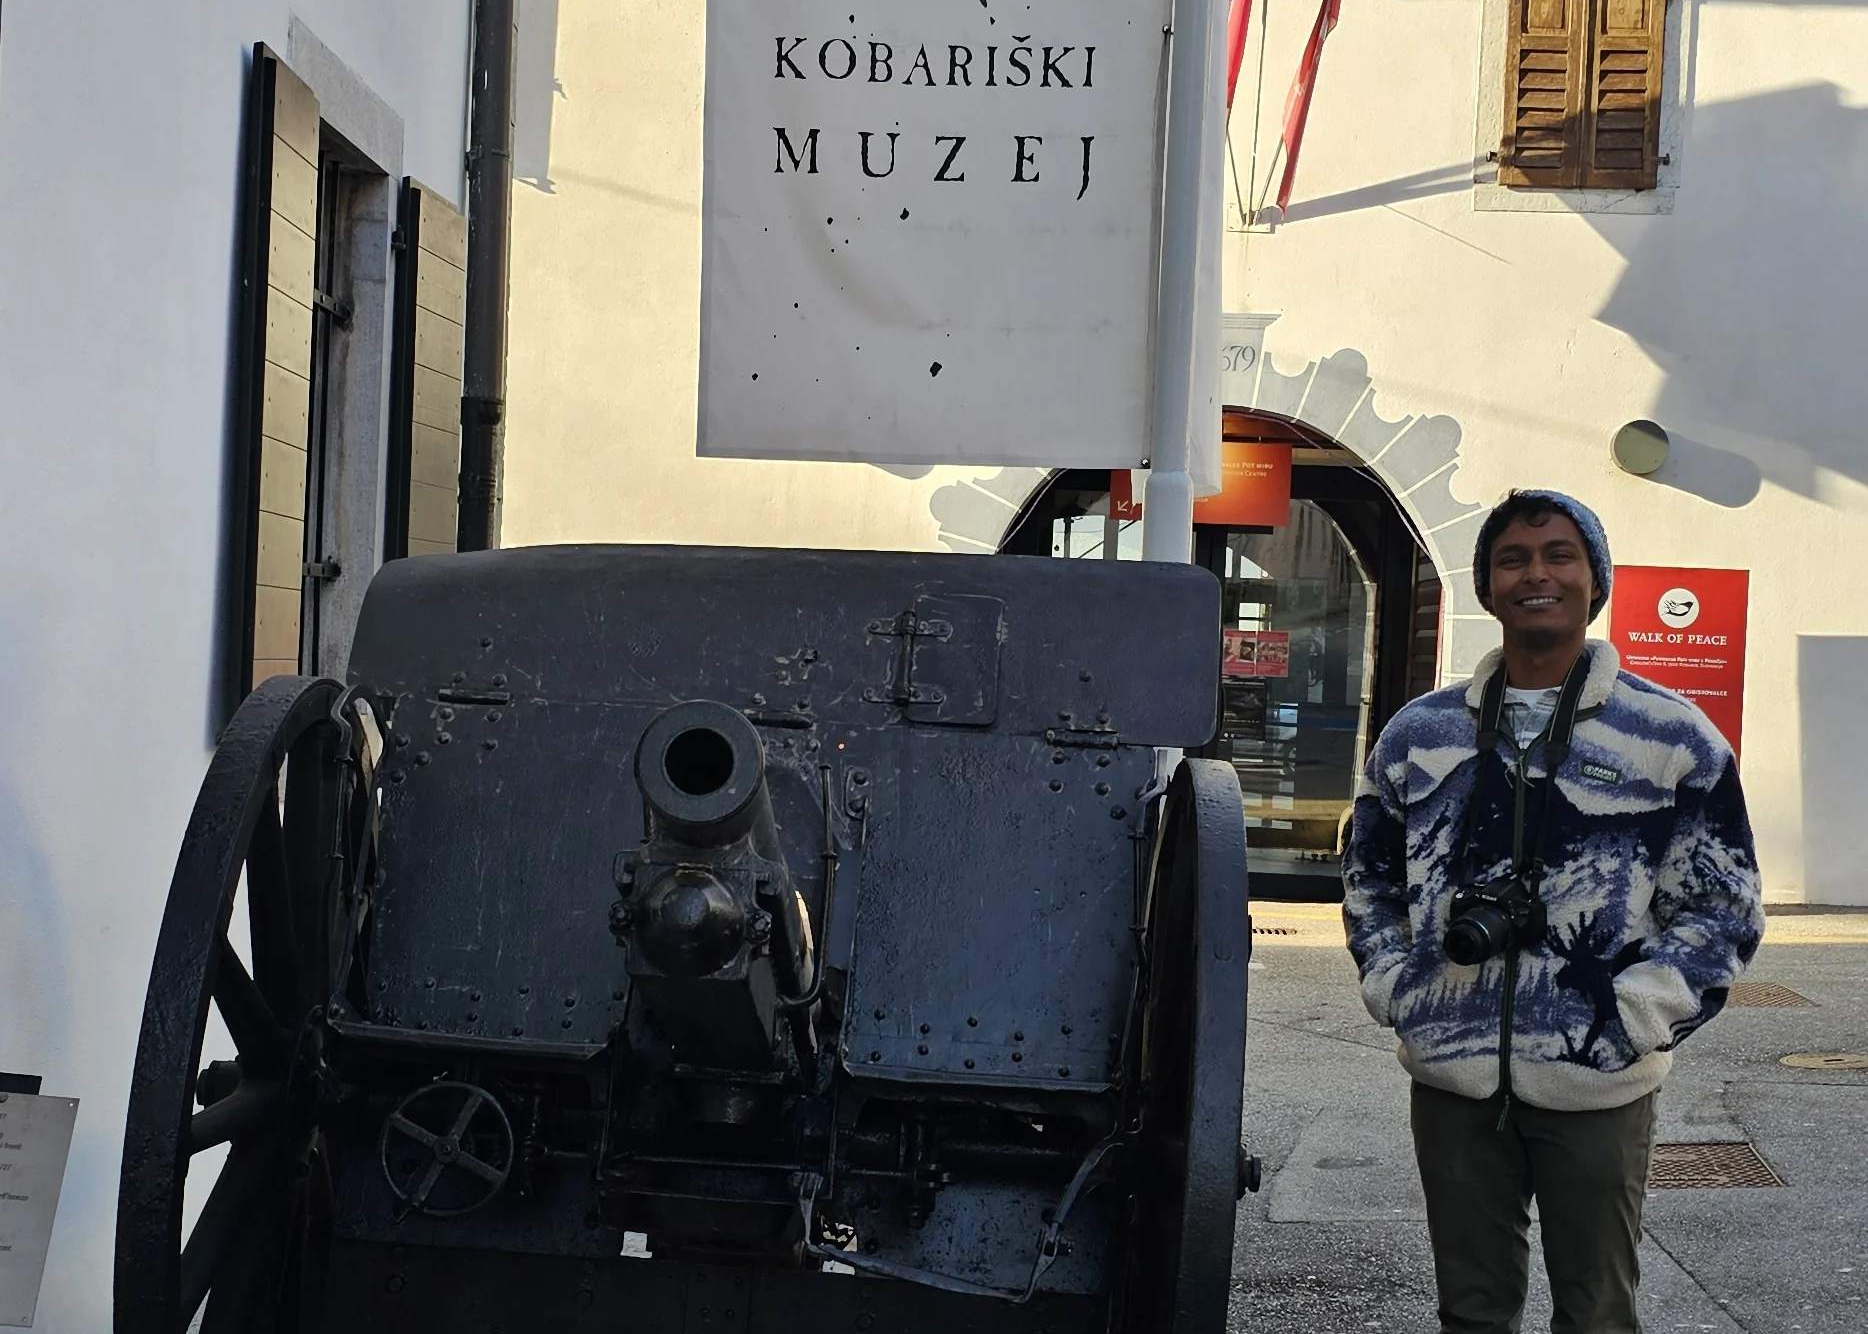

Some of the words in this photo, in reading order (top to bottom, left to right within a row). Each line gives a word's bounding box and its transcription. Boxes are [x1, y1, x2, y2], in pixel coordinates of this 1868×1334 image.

[774, 35, 1096, 88] KOBARIŠKI
[773, 127, 1095, 201] MUZEJ
[1628, 631, 1664, 643] WALK
[1667, 633, 1684, 644] OF
[1687, 634, 1728, 646] PEACE
